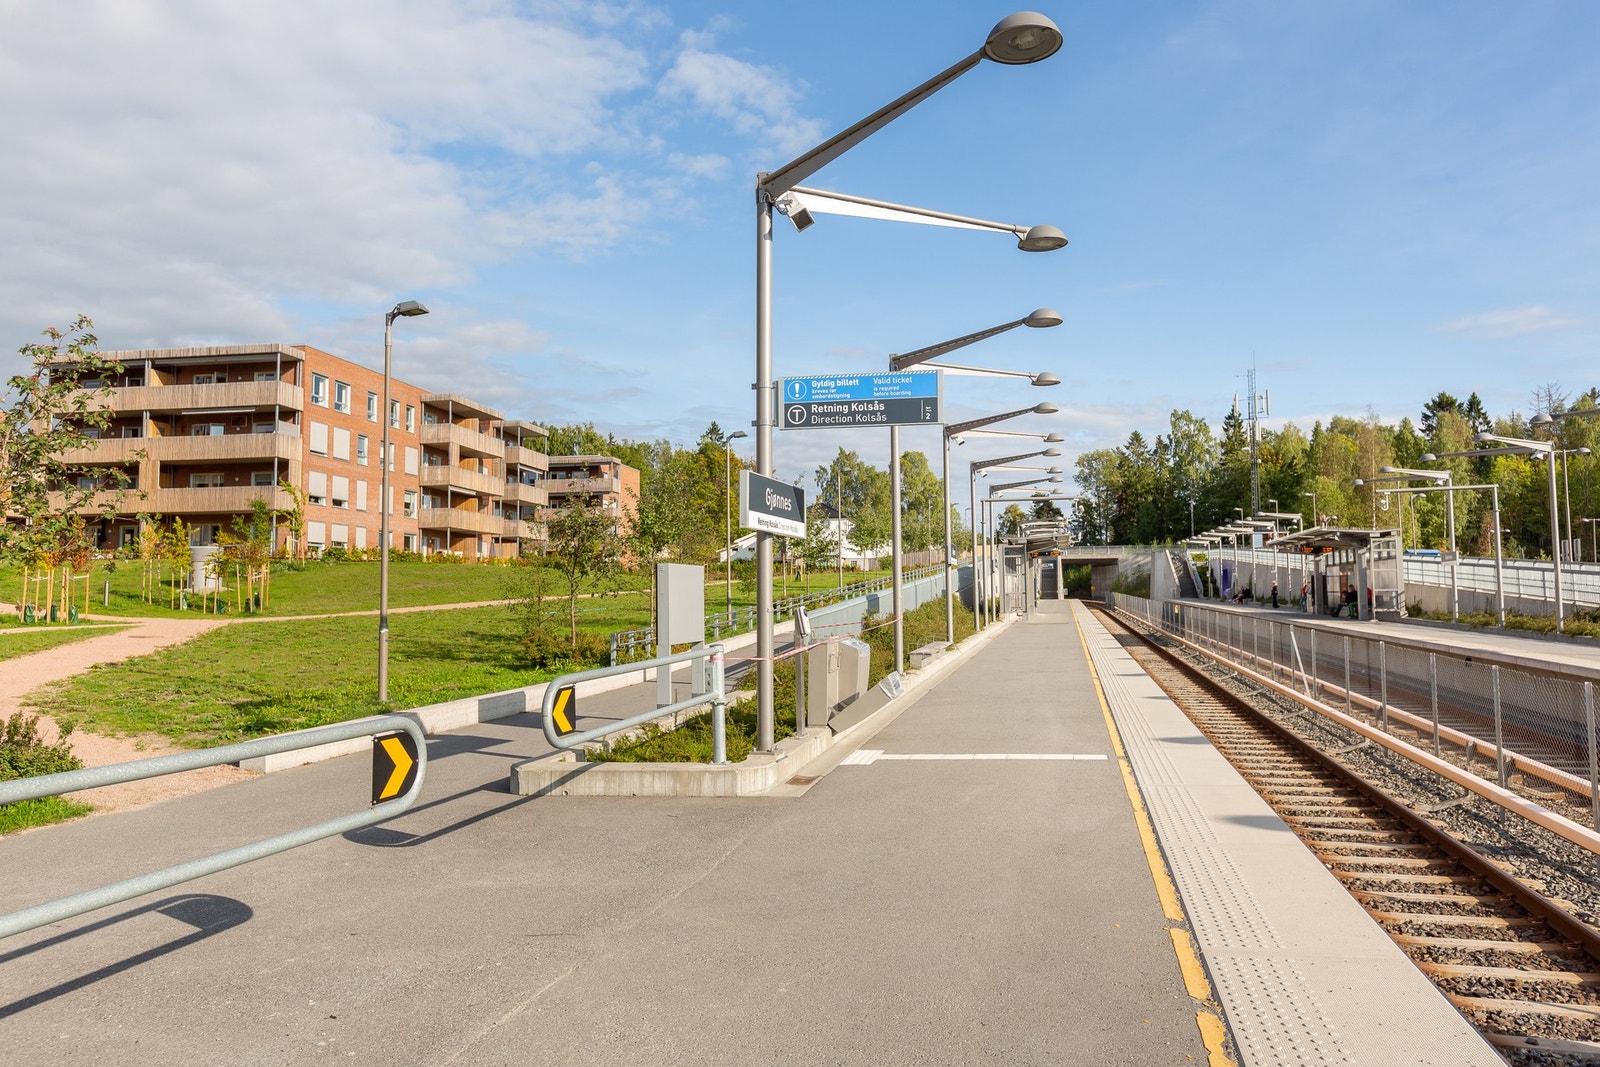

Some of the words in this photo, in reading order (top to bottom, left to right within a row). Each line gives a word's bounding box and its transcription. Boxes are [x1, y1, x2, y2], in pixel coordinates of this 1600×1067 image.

[811, 380, 835, 389] Gyldig
[892, 376, 912, 384] ticket
[811, 404, 848, 413] Retning
[851, 401, 885, 411] Kolsås
[811, 414, 852, 424] Direction
[856, 412, 887, 422] Kolsås
[926, 412, 931, 420] 2
[765, 487, 792, 512] Gjønnes
